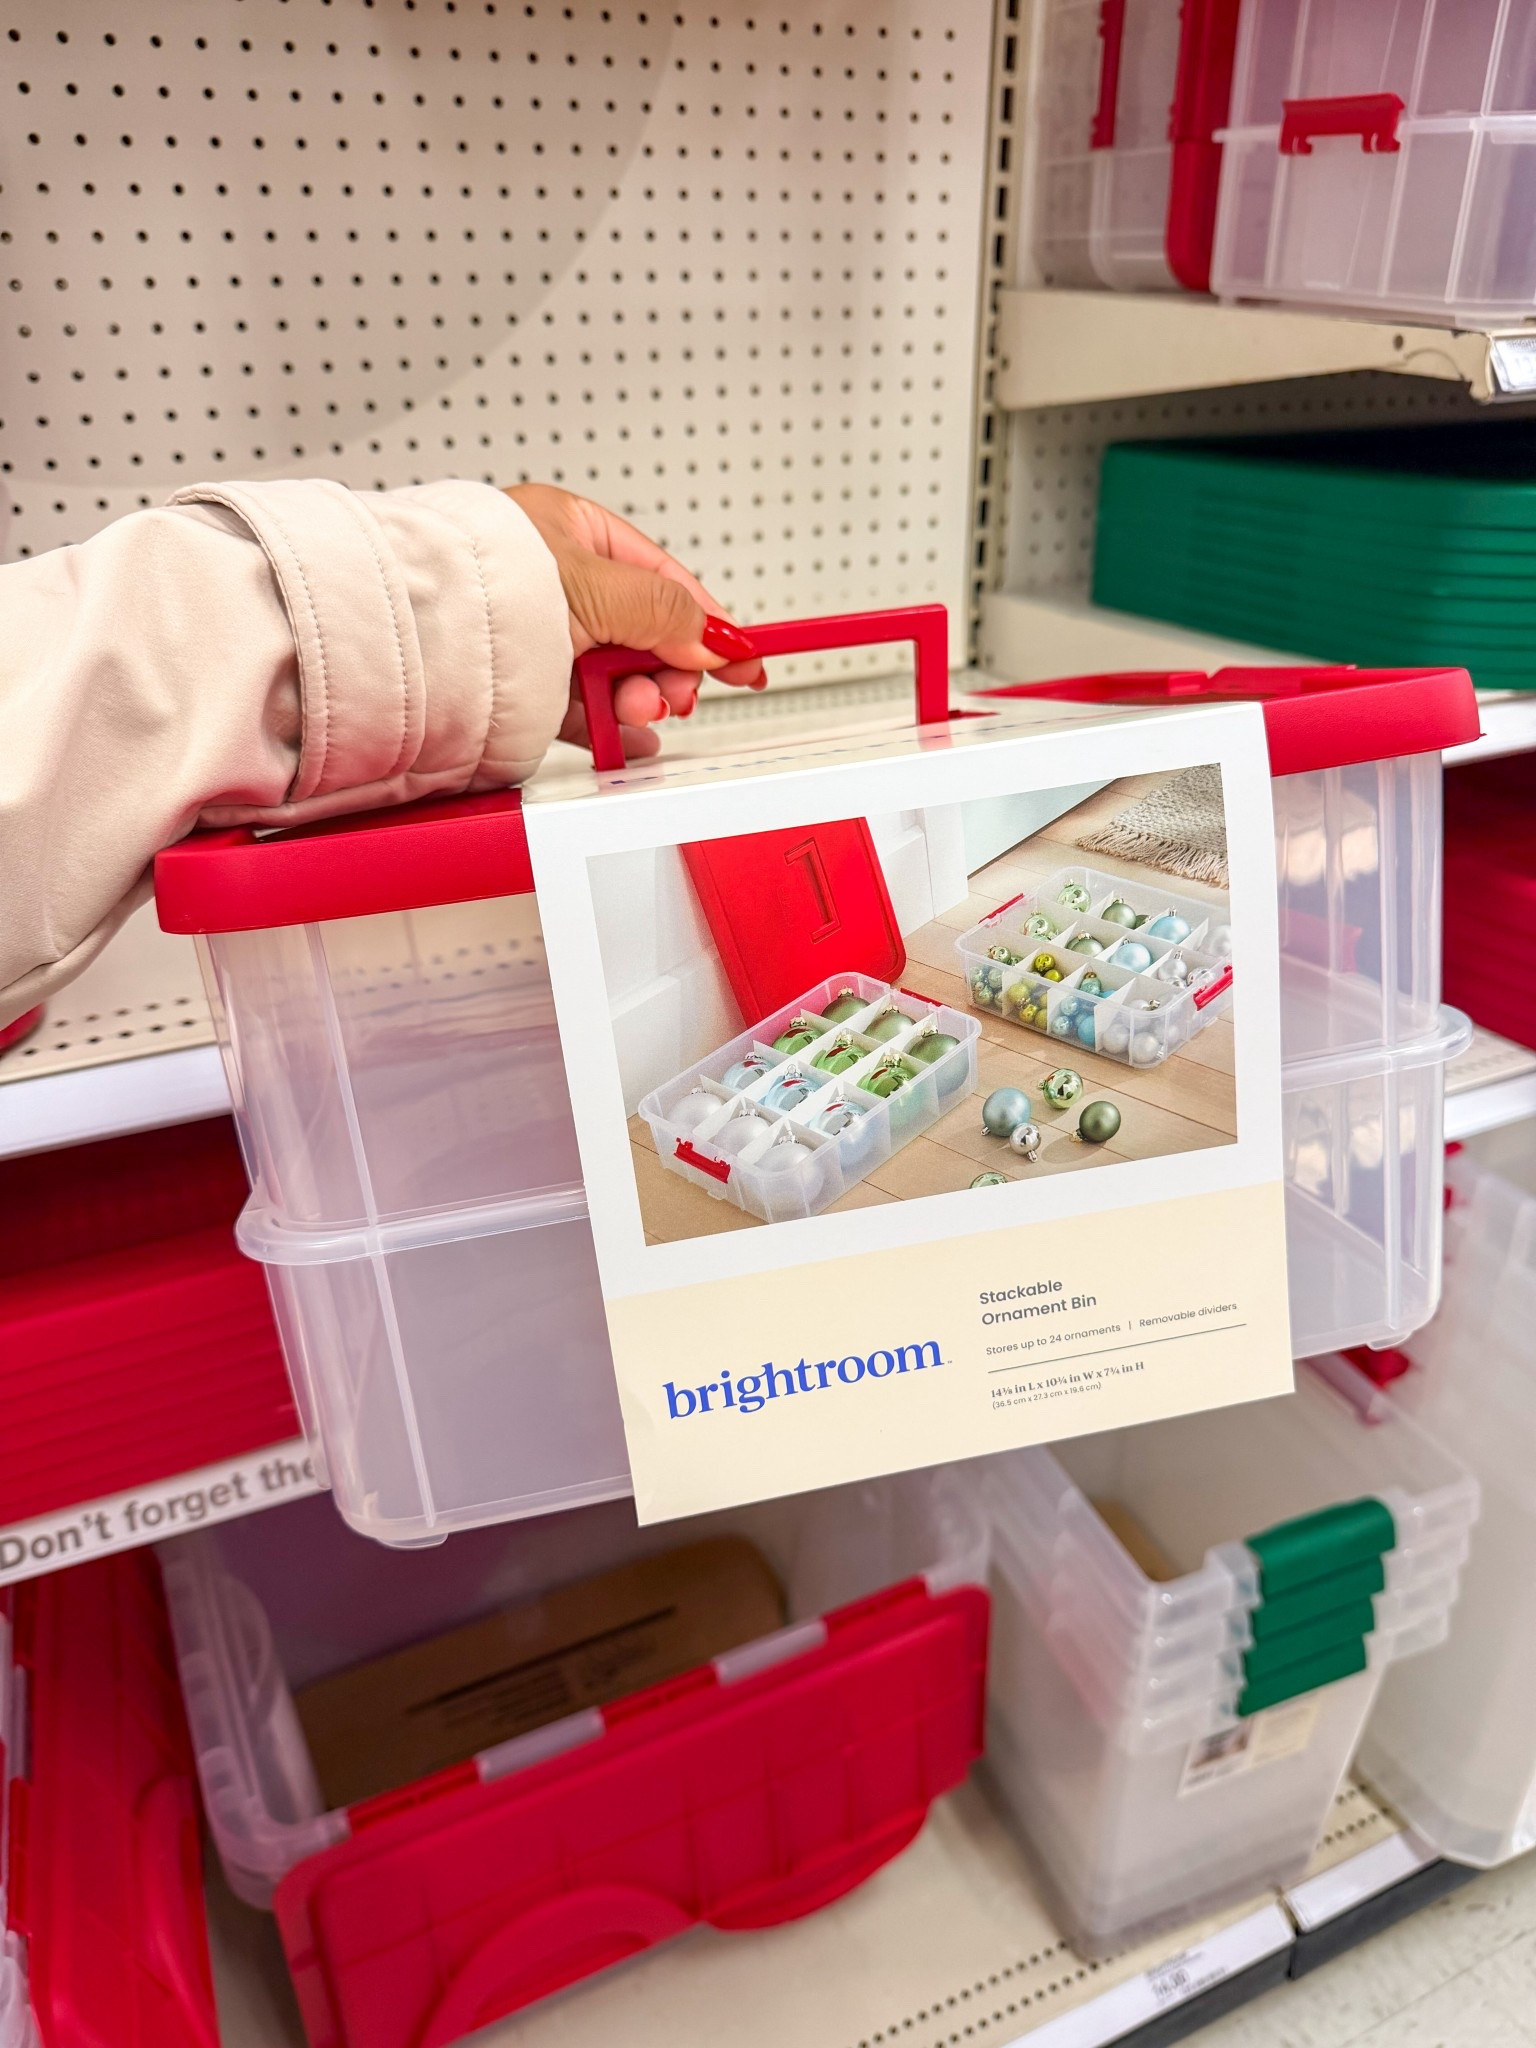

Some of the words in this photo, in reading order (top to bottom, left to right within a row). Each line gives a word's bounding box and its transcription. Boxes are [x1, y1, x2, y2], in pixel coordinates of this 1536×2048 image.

[979, 1280, 1063, 1305] Stackable
[981, 1299, 1068, 1325] Ornament
[1071, 1294, 1097, 1310] Bin
[985, 1343, 1019, 1355] Stores
[1020, 1340, 1035, 1350] up
[1036, 1337, 1047, 1346] to
[1049, 1334, 1062, 1344] 24
[1064, 1323, 1121, 1341] ornaments
[1139, 1310, 1196, 1327] Removable
[1198, 1303, 1237, 1317] dividers
[662, 1340, 945, 1419] brightroom
[1015, 1384, 1027, 1393] in
[1028, 1382, 1036, 1391] L
[1037, 1381, 1043, 1389] x
[1069, 1374, 1081, 1383] in
[1083, 1370, 1094, 1380] W
[1121, 1364, 1133, 1373] in
[1135, 1361, 1144, 1371] H
[992, 1399, 1012, 1410] (36.5
[1013, 1397, 1027, 1405] cm
[1033, 1392, 1048, 1401] 27.3
[1049, 1390, 1063, 1398] cm
[1069, 1385, 1084, 1394] 19.6
[1085, 1381, 1102, 1391] cm)
[0, 1511, 114, 1571] Don't
[122, 1471, 250, 1531] forget
